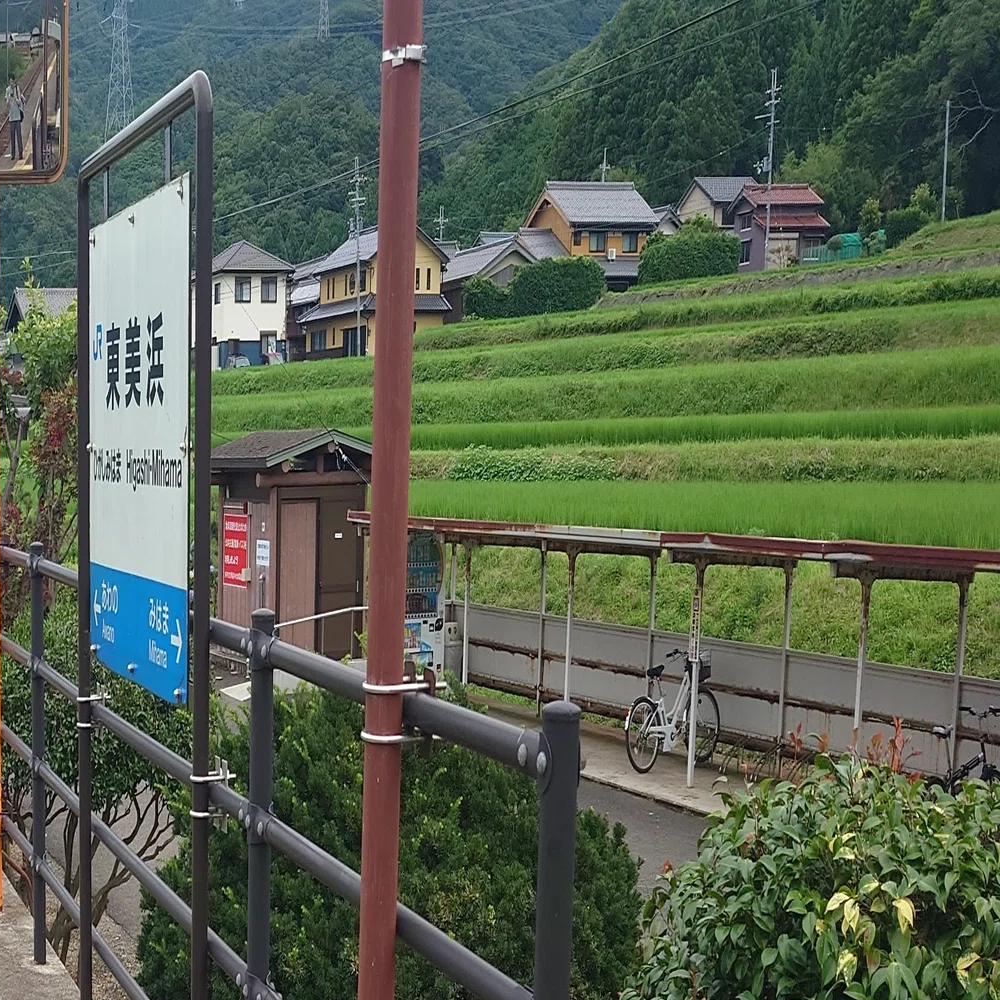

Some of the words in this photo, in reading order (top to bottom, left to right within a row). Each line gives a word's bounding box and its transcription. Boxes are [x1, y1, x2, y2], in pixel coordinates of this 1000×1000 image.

[93, 324, 103, 361] JR
[106, 311, 164, 410] 東美浜
[94, 448, 121, 483] ひがしみはま
[126, 449, 182, 492] Higashi-Mihama
[101, 580, 119, 615] あわの
[149, 598, 169, 635] みはま
[148, 638, 168, 669] Mihama
